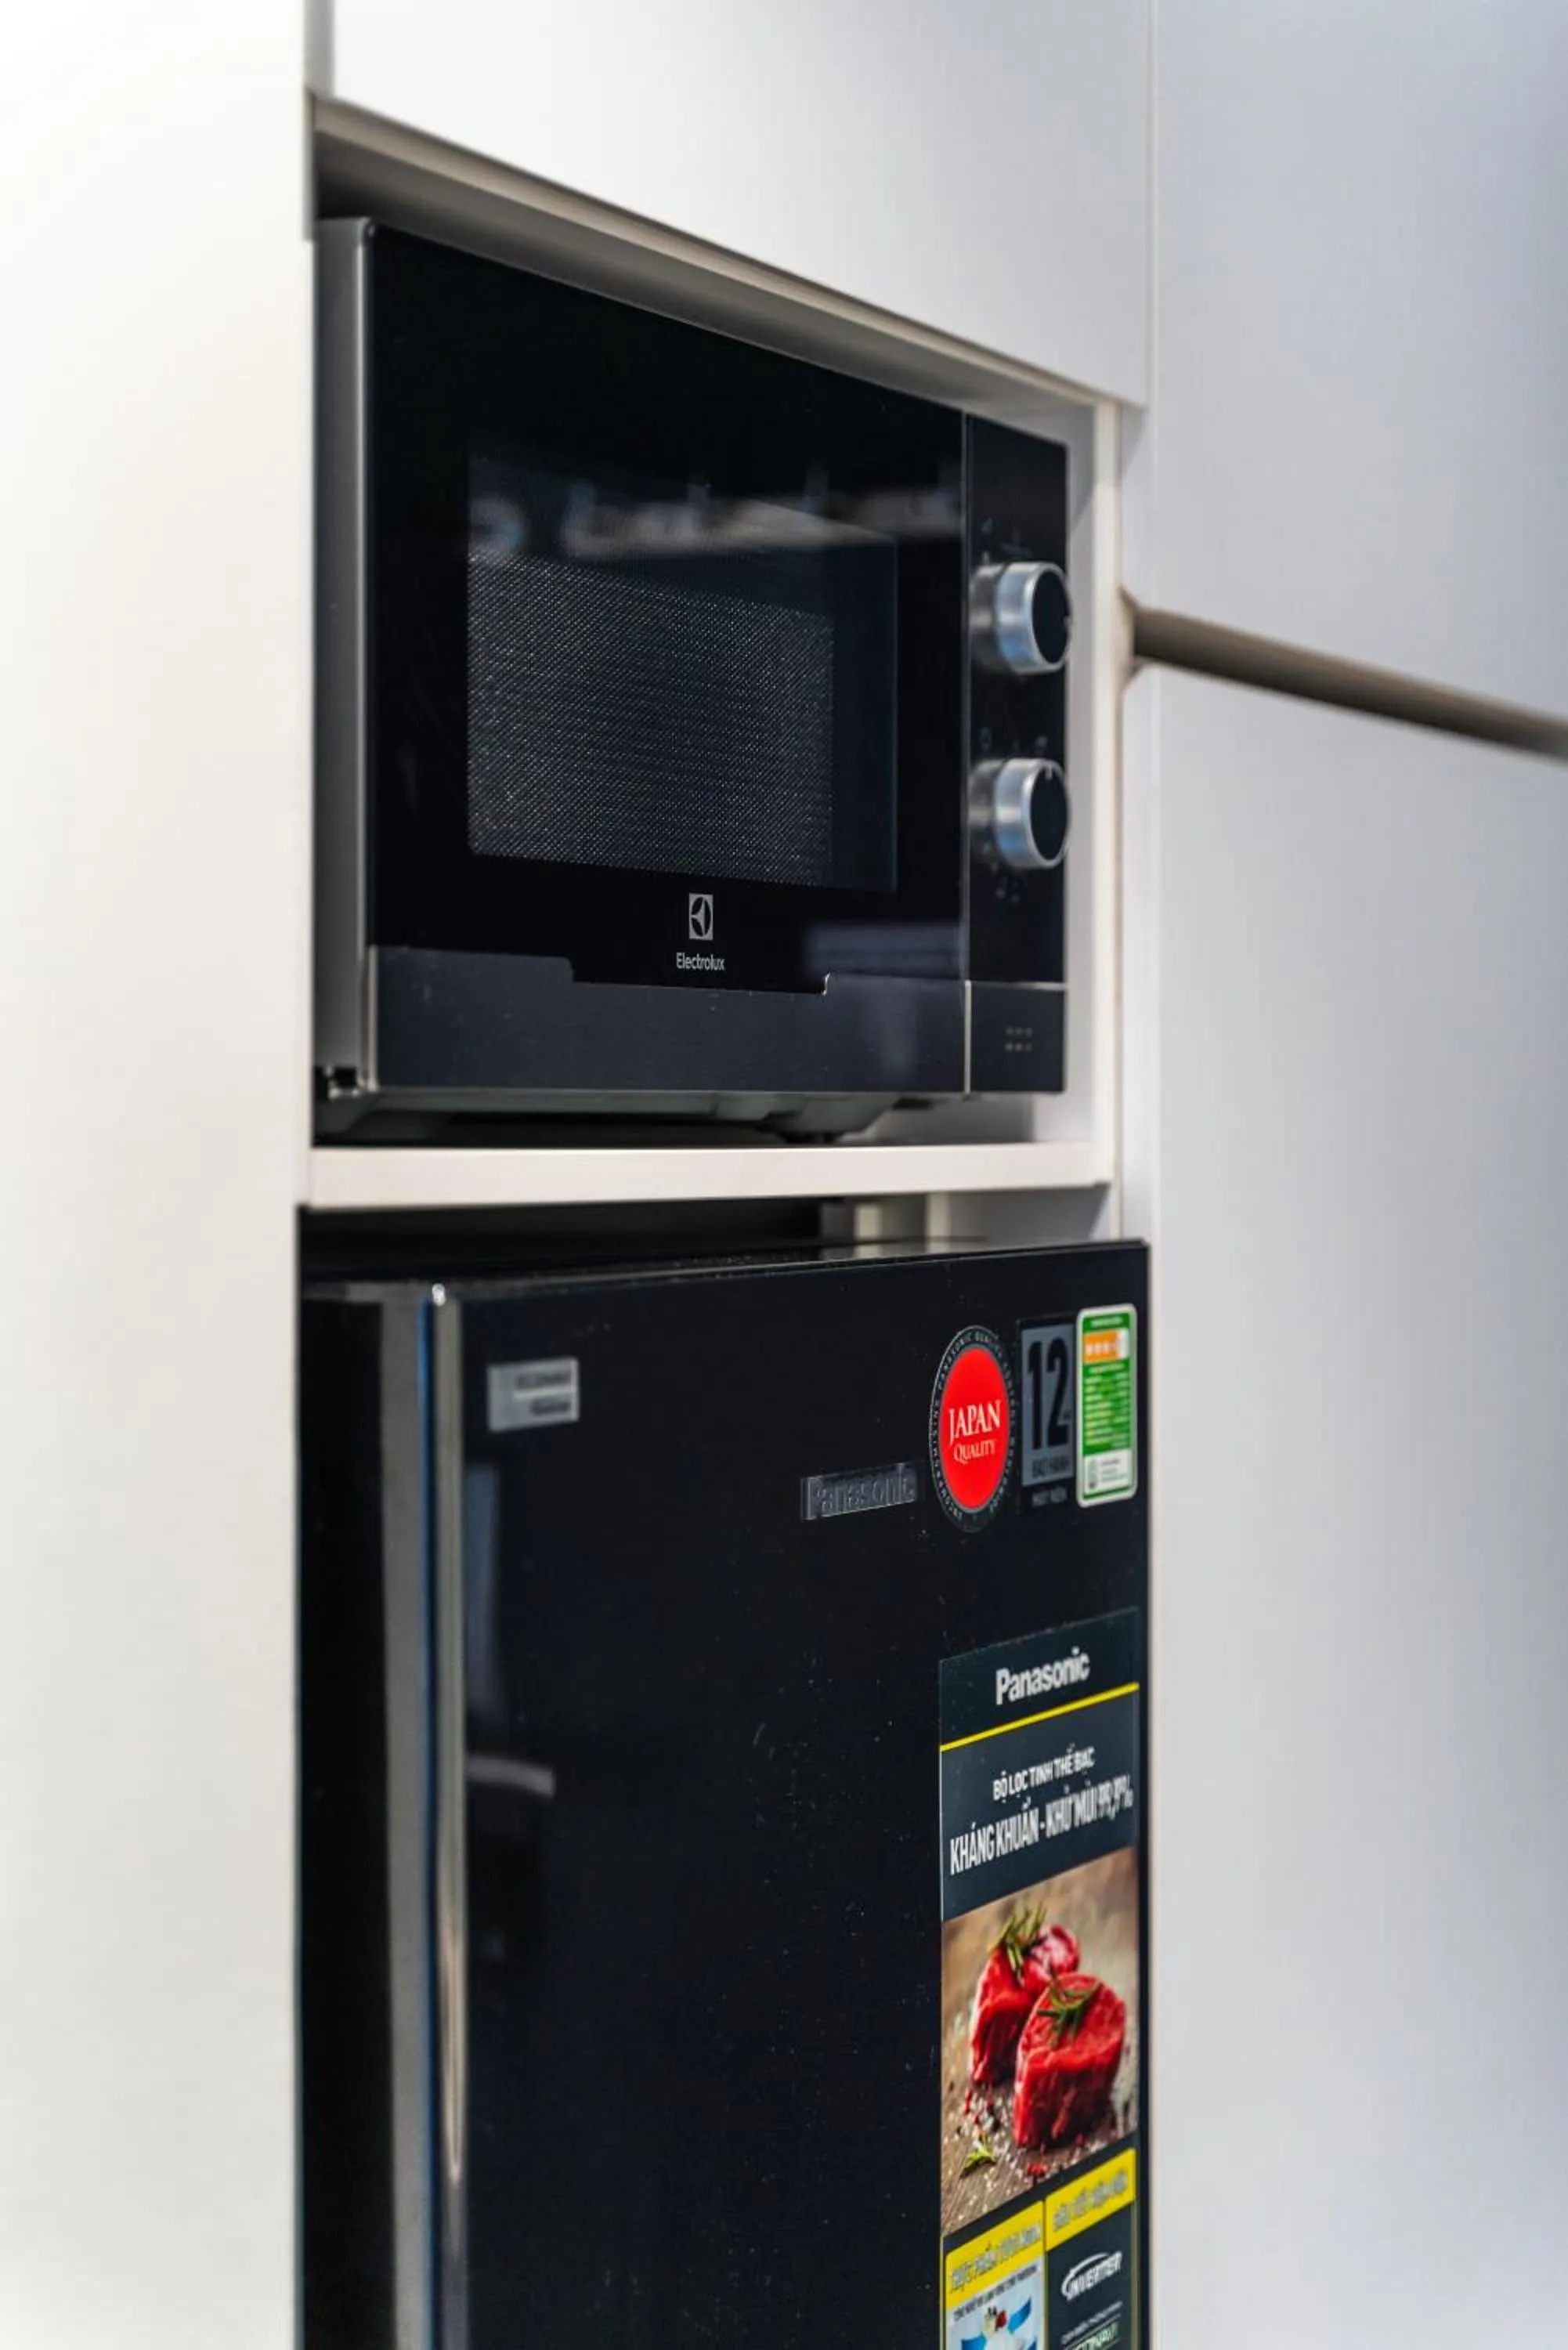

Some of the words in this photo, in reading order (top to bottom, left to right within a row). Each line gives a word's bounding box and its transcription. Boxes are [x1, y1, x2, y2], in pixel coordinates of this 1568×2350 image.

[676, 952, 724, 971] Electrolux
[1028, 1337, 1070, 1450] 12
[948, 1399, 1002, 1445] JAPAN
[953, 1437, 996, 1464] QUALITY
[807, 1463, 916, 1520] Panasonic
[995, 1646, 1091, 1705] Panasonic
[949, 1821, 995, 1876] KHÁNG
